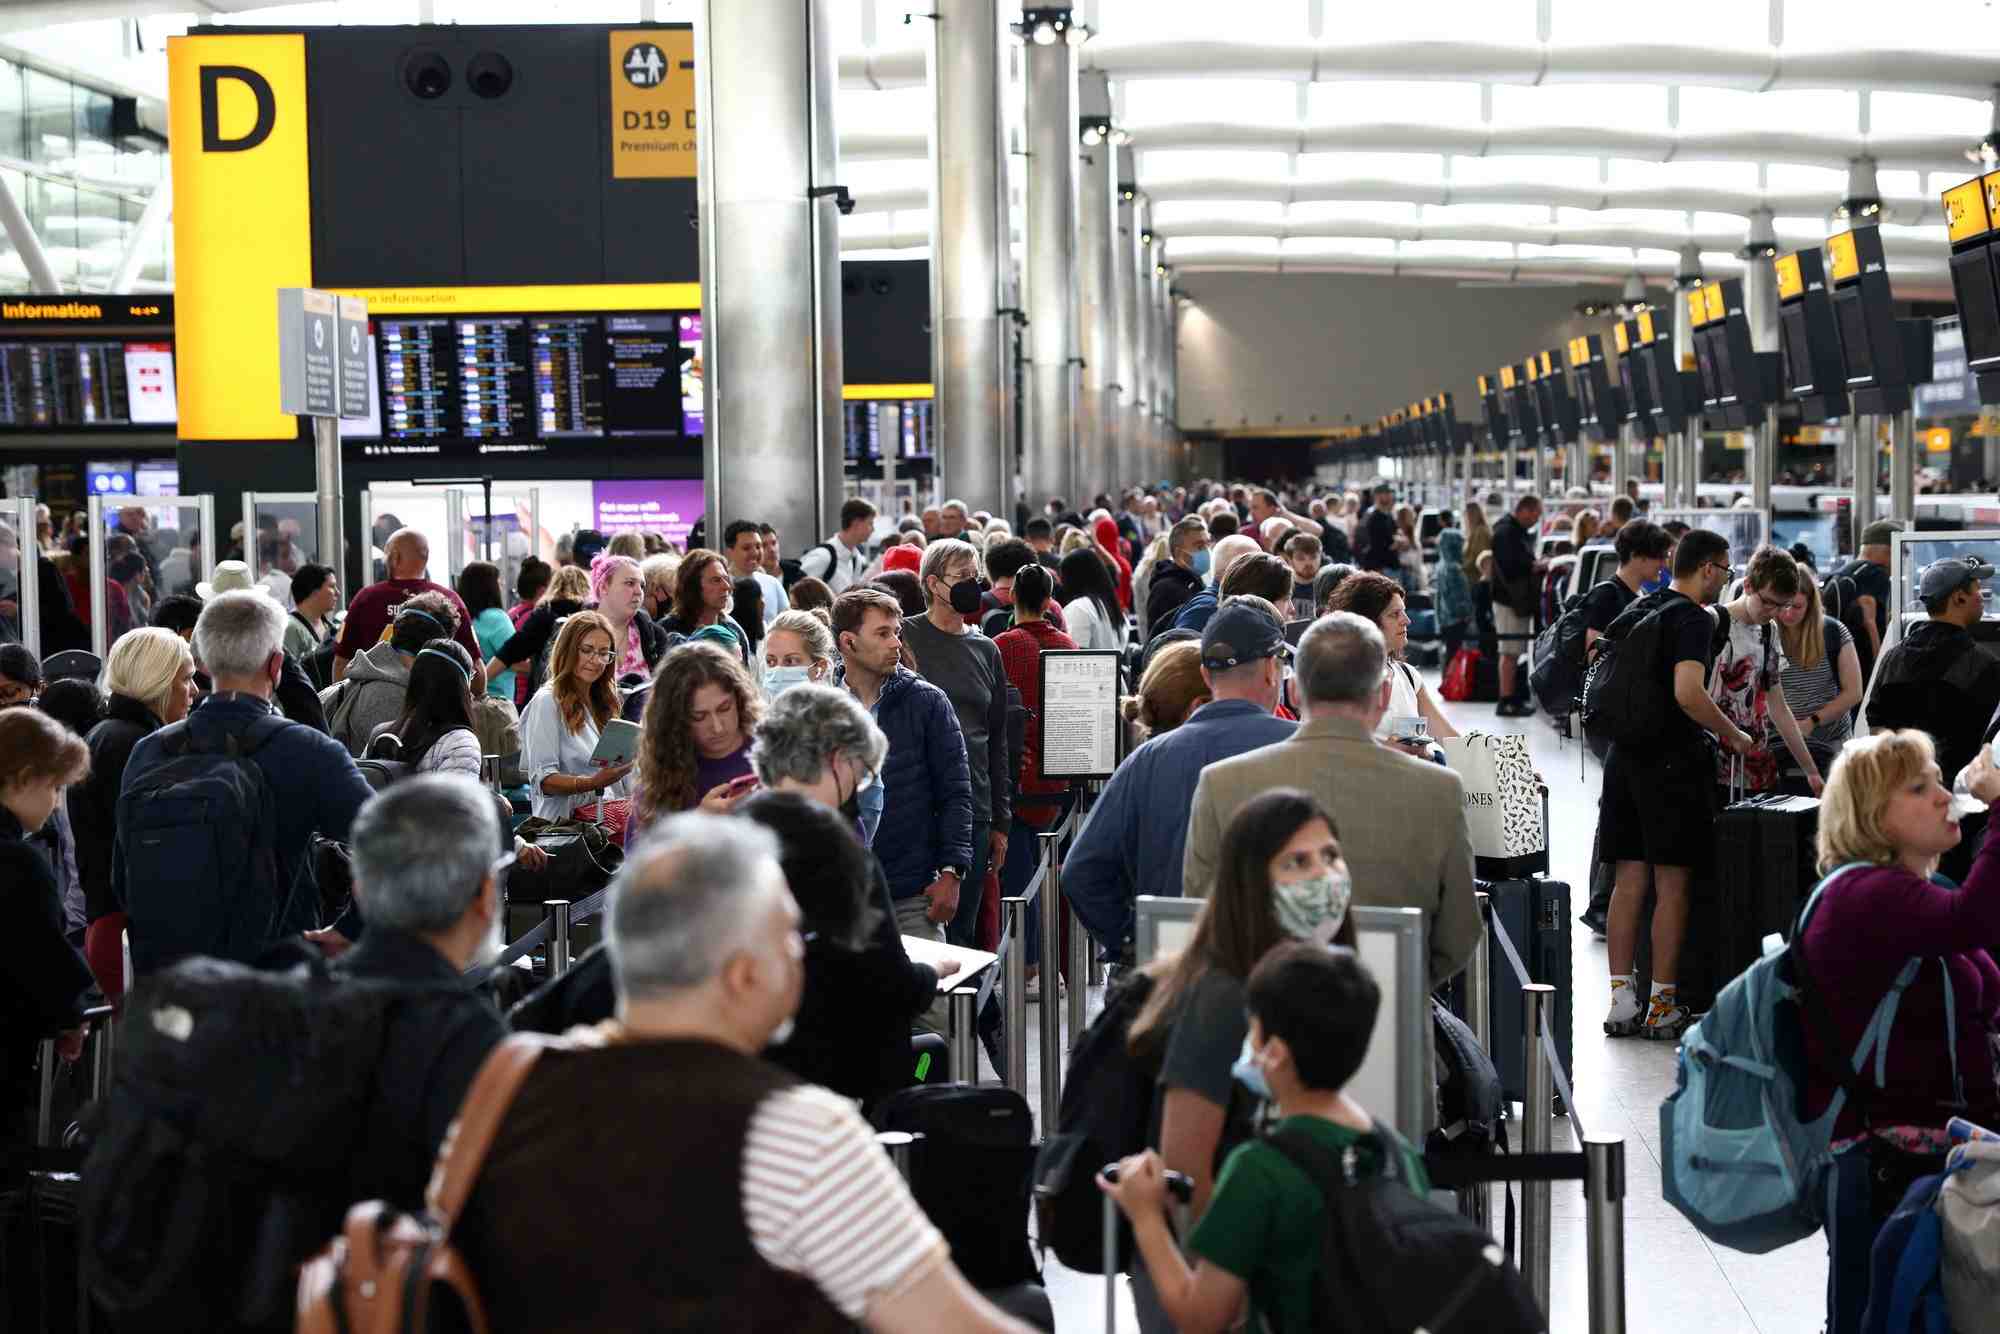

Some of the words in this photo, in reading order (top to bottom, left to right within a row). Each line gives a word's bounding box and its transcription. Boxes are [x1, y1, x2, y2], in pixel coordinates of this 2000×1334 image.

[199, 64, 277, 153] D
[623, 110, 671, 130] D19
[620, 140, 680, 152] Premium
[380, 291, 457, 304] information
[2, 301, 102, 318] Information
